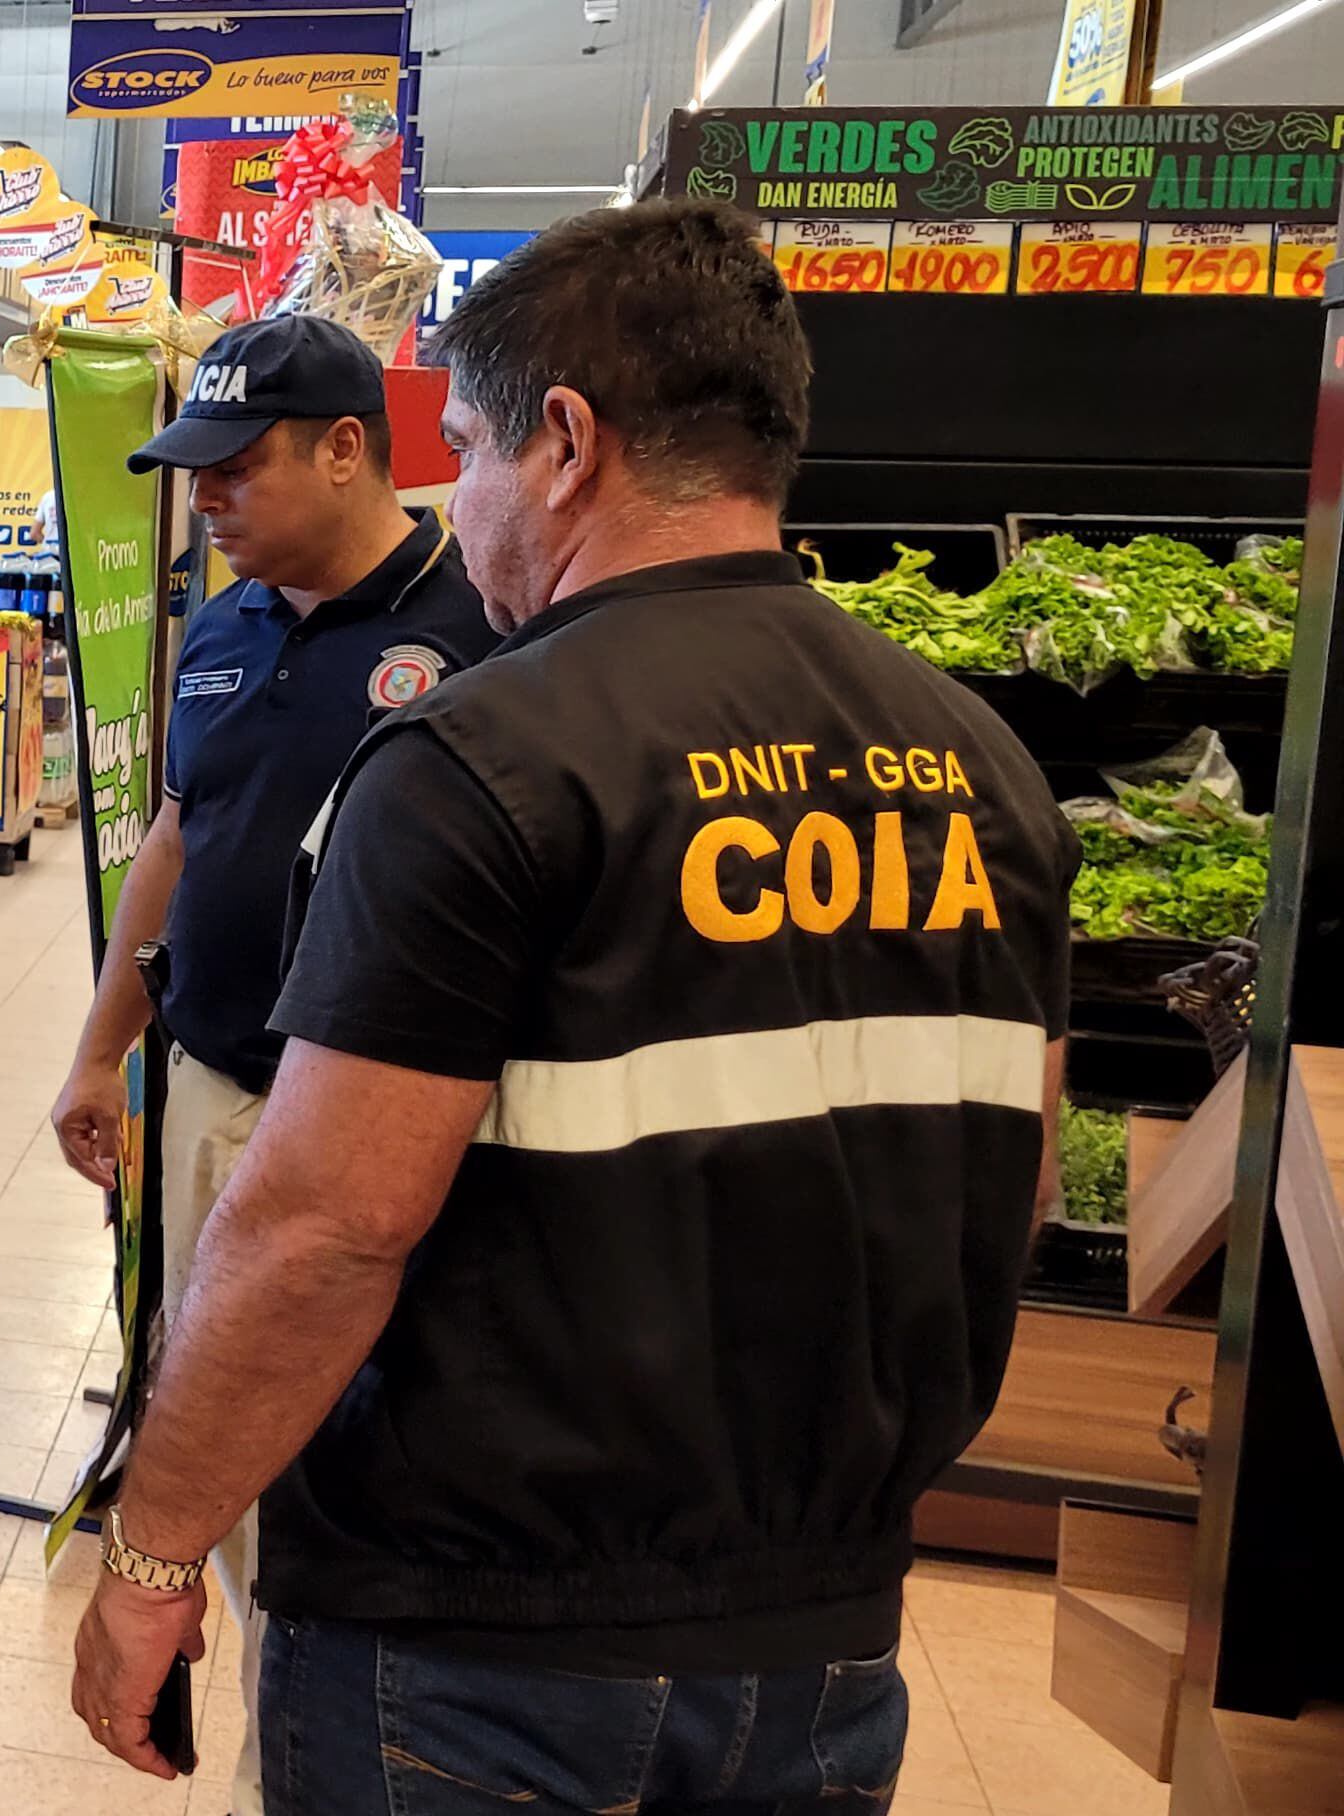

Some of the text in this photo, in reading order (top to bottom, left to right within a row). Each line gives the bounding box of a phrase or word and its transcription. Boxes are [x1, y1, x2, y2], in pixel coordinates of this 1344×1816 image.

[80, 70, 206, 90] STOCK
[226, 67, 392, 91] Lo bueno para vos
[1023, 114, 1219, 144] ANTIOXIDANTES
[745, 120, 939, 174] VERDES
[1016, 147, 1156, 178] PROTEGEN
[757, 177, 899, 209] DAN ENERGÍA
[216, 211, 249, 247] AL
[795, 223, 841, 240] RUDA
[783, 249, 886, 292] 1650
[895, 249, 1000, 292] 1900
[1030, 244, 1140, 293] 2500
[1164, 247, 1261, 294] 750
[14, 489, 31, 501] en
[97, 539, 139, 573] Promo
[687, 743, 817, 800] DNIT
[864, 745, 975, 799] GGA
[680, 810, 1004, 944] COIA
